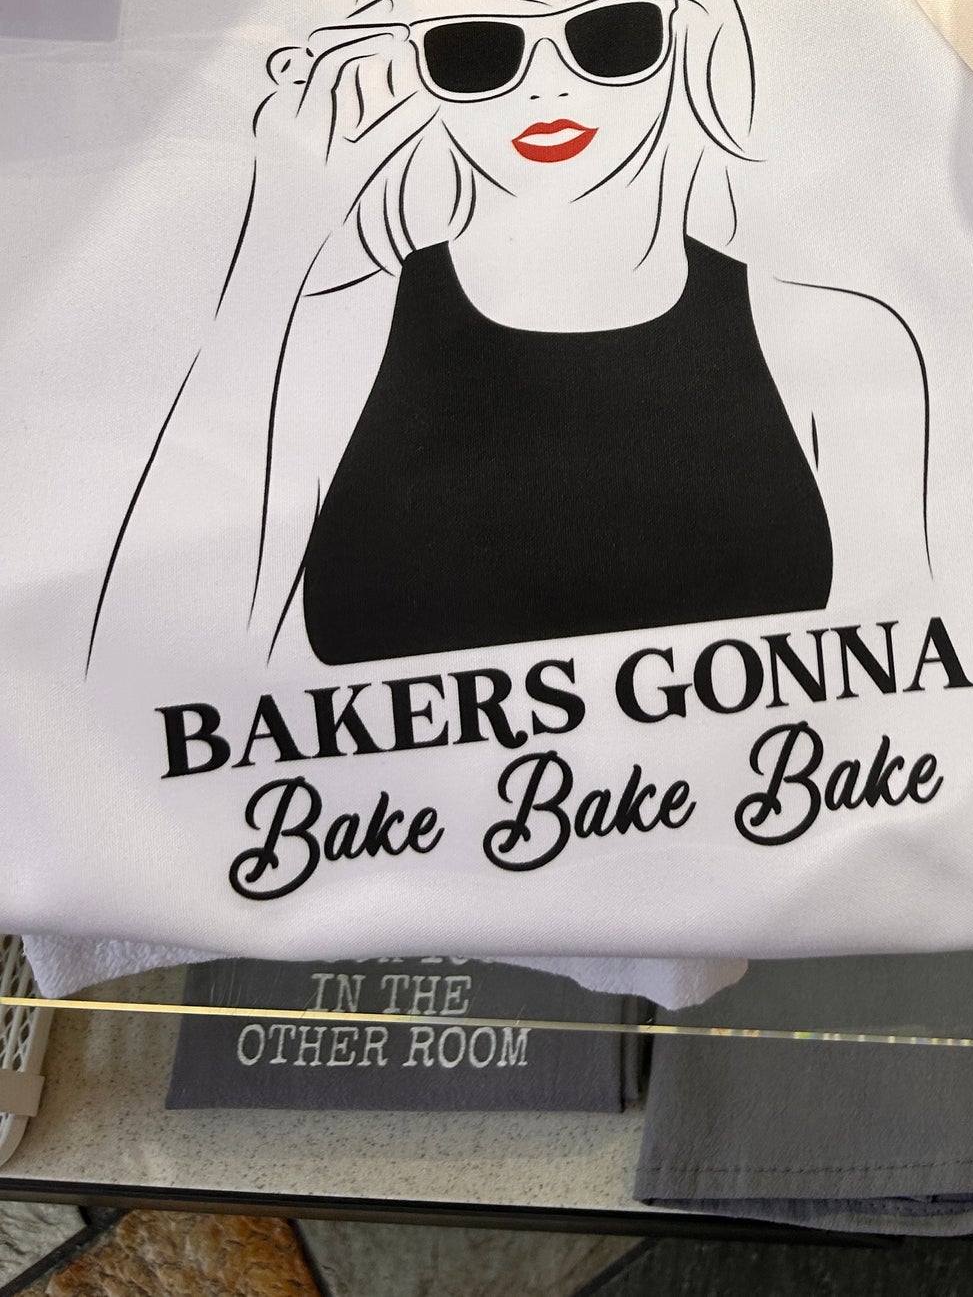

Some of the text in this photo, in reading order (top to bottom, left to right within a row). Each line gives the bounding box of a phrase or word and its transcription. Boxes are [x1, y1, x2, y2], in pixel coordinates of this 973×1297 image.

[154, 657, 586, 779] BAKERS
[229, 720, 944, 901] Bake Bake Bake
[305, 973, 472, 1015] IN THE
[237, 1023, 533, 1069] OTHER ROOM
